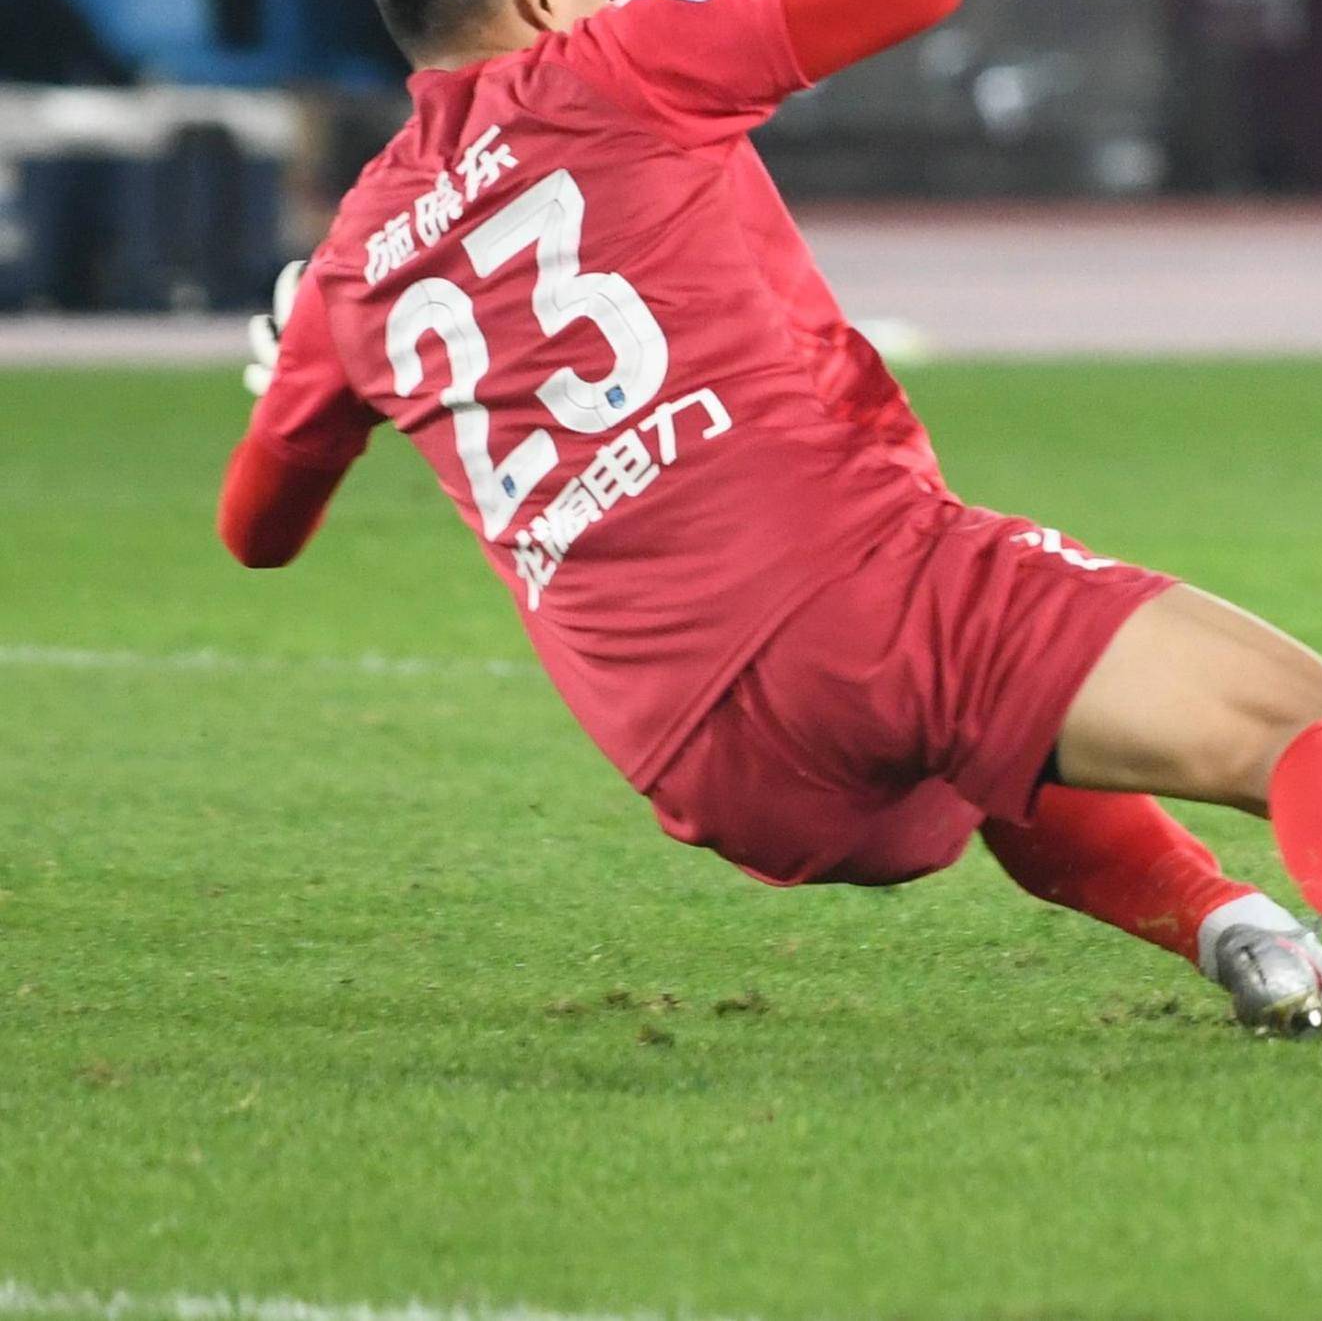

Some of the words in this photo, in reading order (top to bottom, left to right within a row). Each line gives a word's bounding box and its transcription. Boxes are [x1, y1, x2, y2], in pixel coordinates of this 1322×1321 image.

[363, 124, 520, 287] 施晓东
[385, 168, 669, 542] 23
